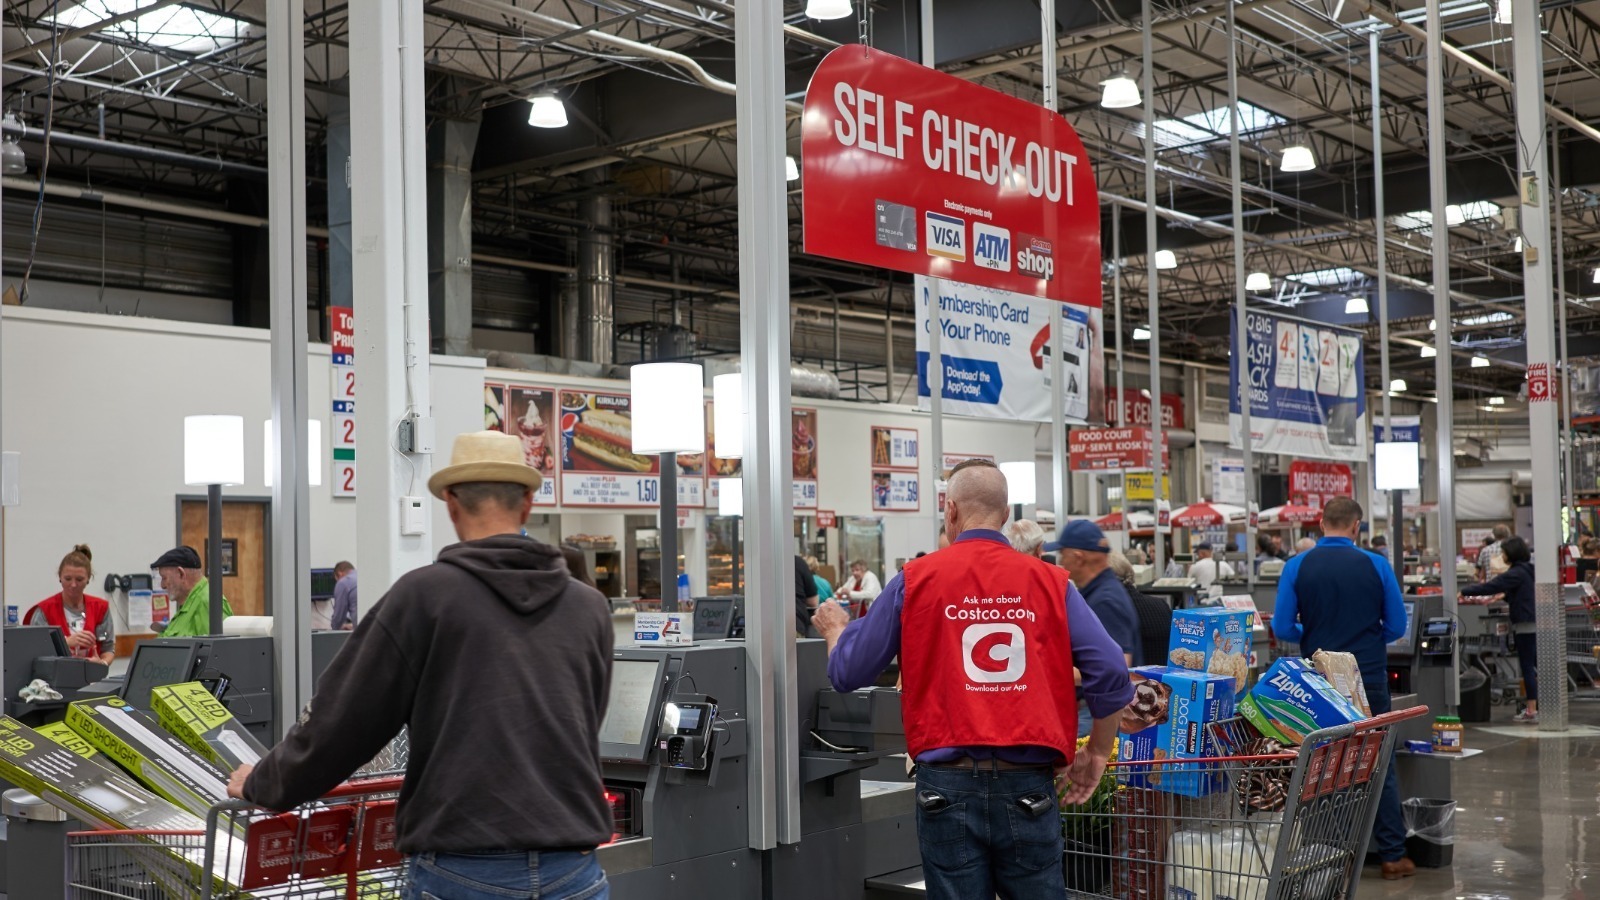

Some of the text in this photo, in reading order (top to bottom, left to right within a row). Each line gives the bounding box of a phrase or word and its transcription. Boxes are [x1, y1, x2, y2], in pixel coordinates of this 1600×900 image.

[833, 81, 1077, 206] SELF CHECK-OUT
[944, 199, 993, 220] Electronic payments only
[906, 242, 917, 250] VISA
[931, 224, 961, 249] VISA
[975, 232, 1009, 262] ATM
[1017, 247, 1054, 280] shop
[924, 287, 998, 322] mbership
[1000, 302, 1029, 324] Card
[940, 318, 971, 340] Your
[974, 322, 1011, 346] Phone
[1255, 316, 1272, 334] BIG
[1247, 342, 1272, 366] ASH
[946, 365, 991, 383] Download the
[1529, 369, 1547, 377] FIRE
[596, 397, 628, 407] KIRKLAND
[1108, 399, 1174, 426] TIE CEER
[343, 419, 354, 443] 2
[1078, 429, 1132, 442] FOOD COURT
[904, 440, 917, 457] 1.00
[1115, 441, 1142, 451] KIOSK
[343, 467, 354, 491] 2
[1293, 471, 1348, 493] MEMBERSHIP
[637, 479, 657, 502] 1.50
[963, 595, 979, 604] Ask
[996, 594, 1021, 603] about
[702, 608, 724, 620] Open
[945, 604, 1035, 622] Costco.com
[1179, 627, 1204, 637] TREATS
[142, 661, 177, 682] Open
[965, 683, 999, 692] Download
[1013, 683, 1027, 692] App
[1269, 670, 1312, 703] Ziploc
[199, 699, 227, 718] LED
[1240, 701, 1257, 719] 580
[6, 736, 35, 750] LED
[80, 717, 93, 733] LED
[94, 727, 138, 766] SHOPLIGHT
[1174, 697, 1189, 771] DOG BISCUTS
[61, 737, 91, 755] LED
[260, 857, 289, 868] COSTCO
